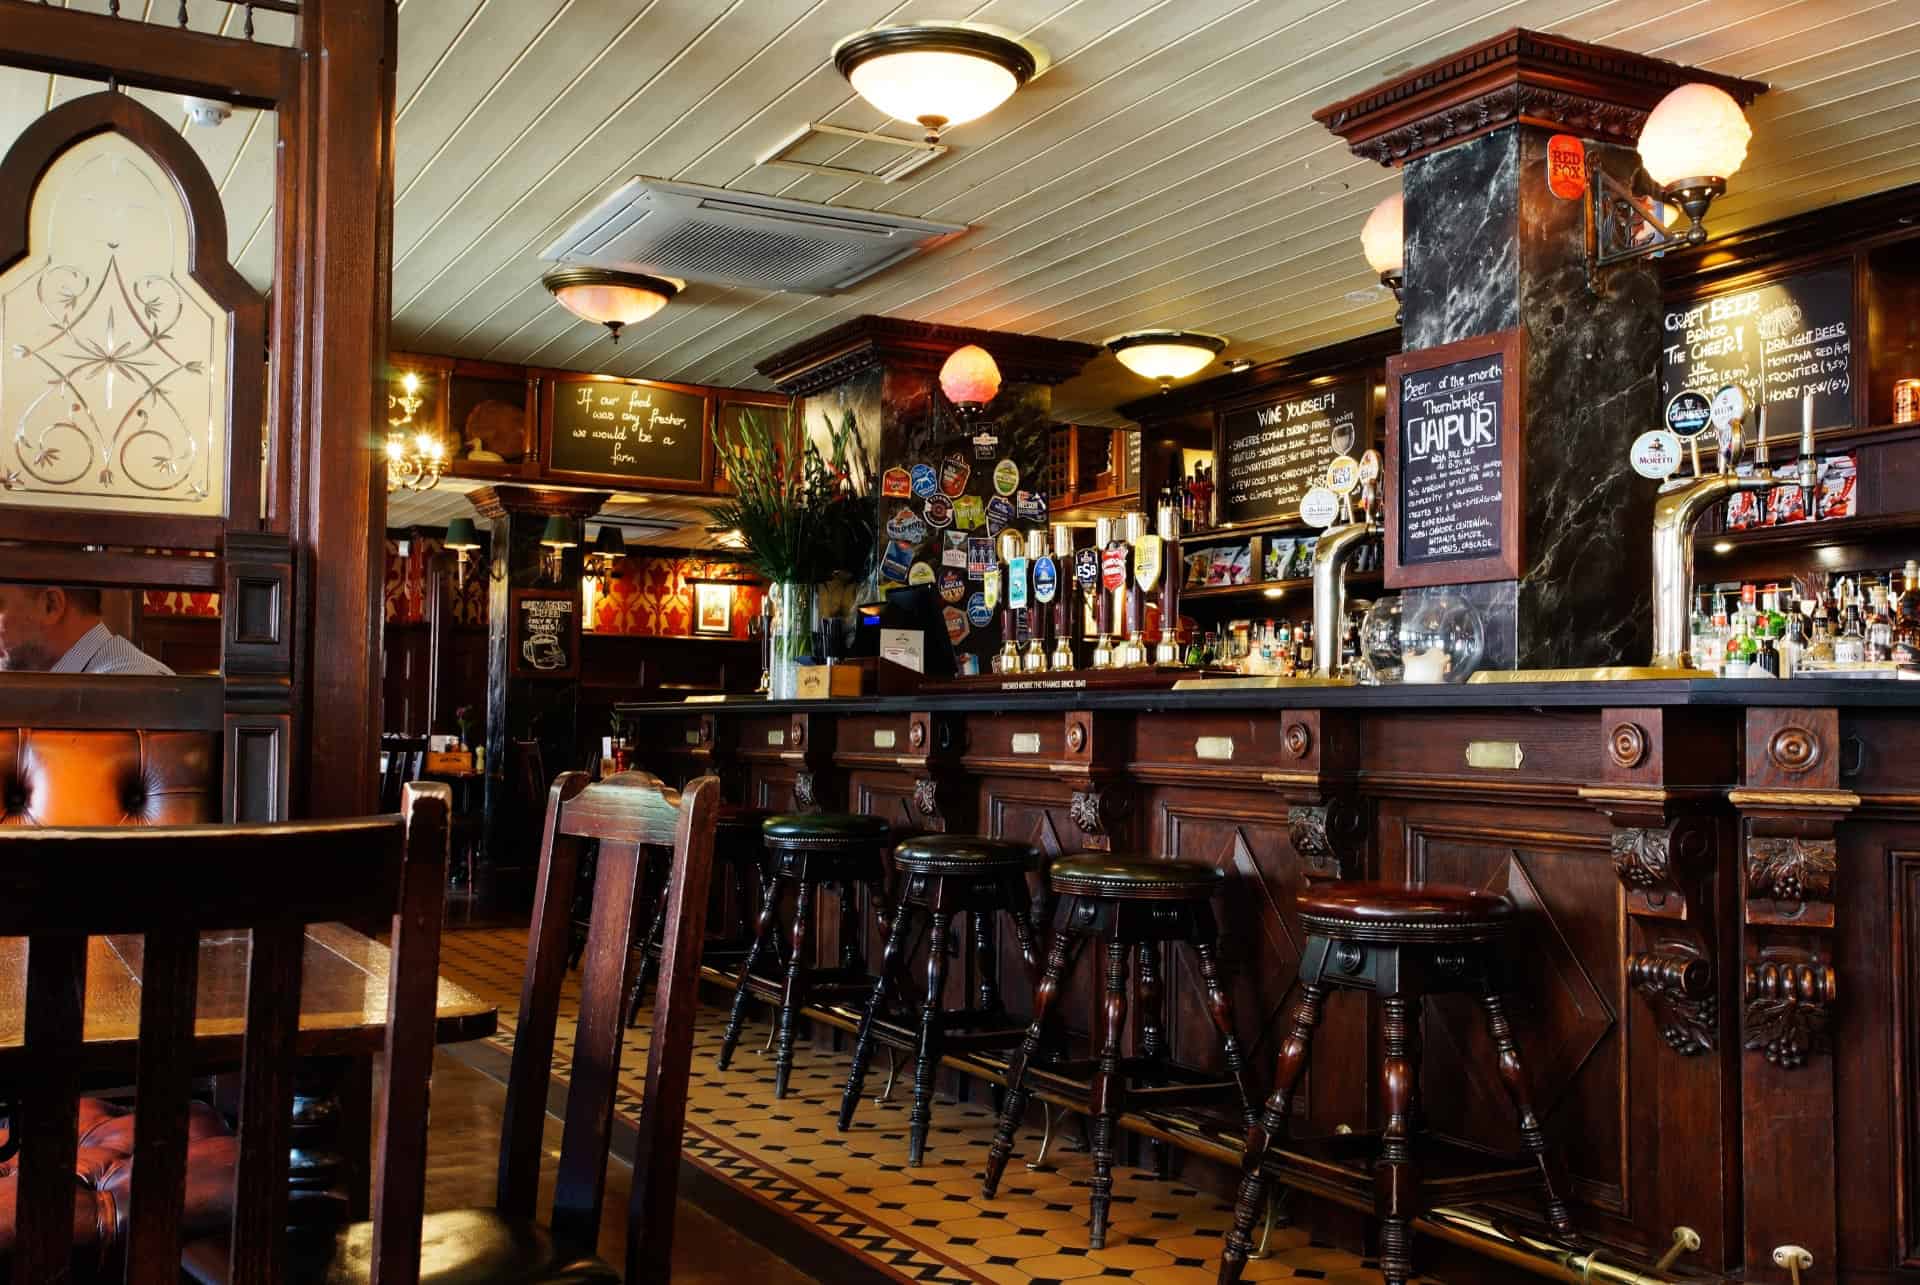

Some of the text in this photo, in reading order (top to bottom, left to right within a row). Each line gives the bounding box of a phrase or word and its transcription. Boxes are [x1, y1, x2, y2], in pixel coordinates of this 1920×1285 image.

[1664, 292, 1761, 331] CRAFT BEER
[1815, 322, 1847, 341] BEER
[1767, 349, 1813, 368] MONTANA
[1404, 364, 1503, 402] Beer of the month
[1769, 386, 1800, 402] HONEY
[1803, 381, 1827, 397] DEW
[577, 387, 593, 414] If
[600, 396, 619, 406] our
[1286, 392, 1335, 421] YOURSELF!
[1422, 391, 1486, 416] Thornbridge
[592, 410, 615, 421] was
[621, 413, 641, 432] any
[1669, 408, 1710, 422] GUINNESS
[572, 425, 676, 445] we would be a
[1413, 408, 1493, 455] JAIPUR
[1077, 563, 1097, 579] ESB
